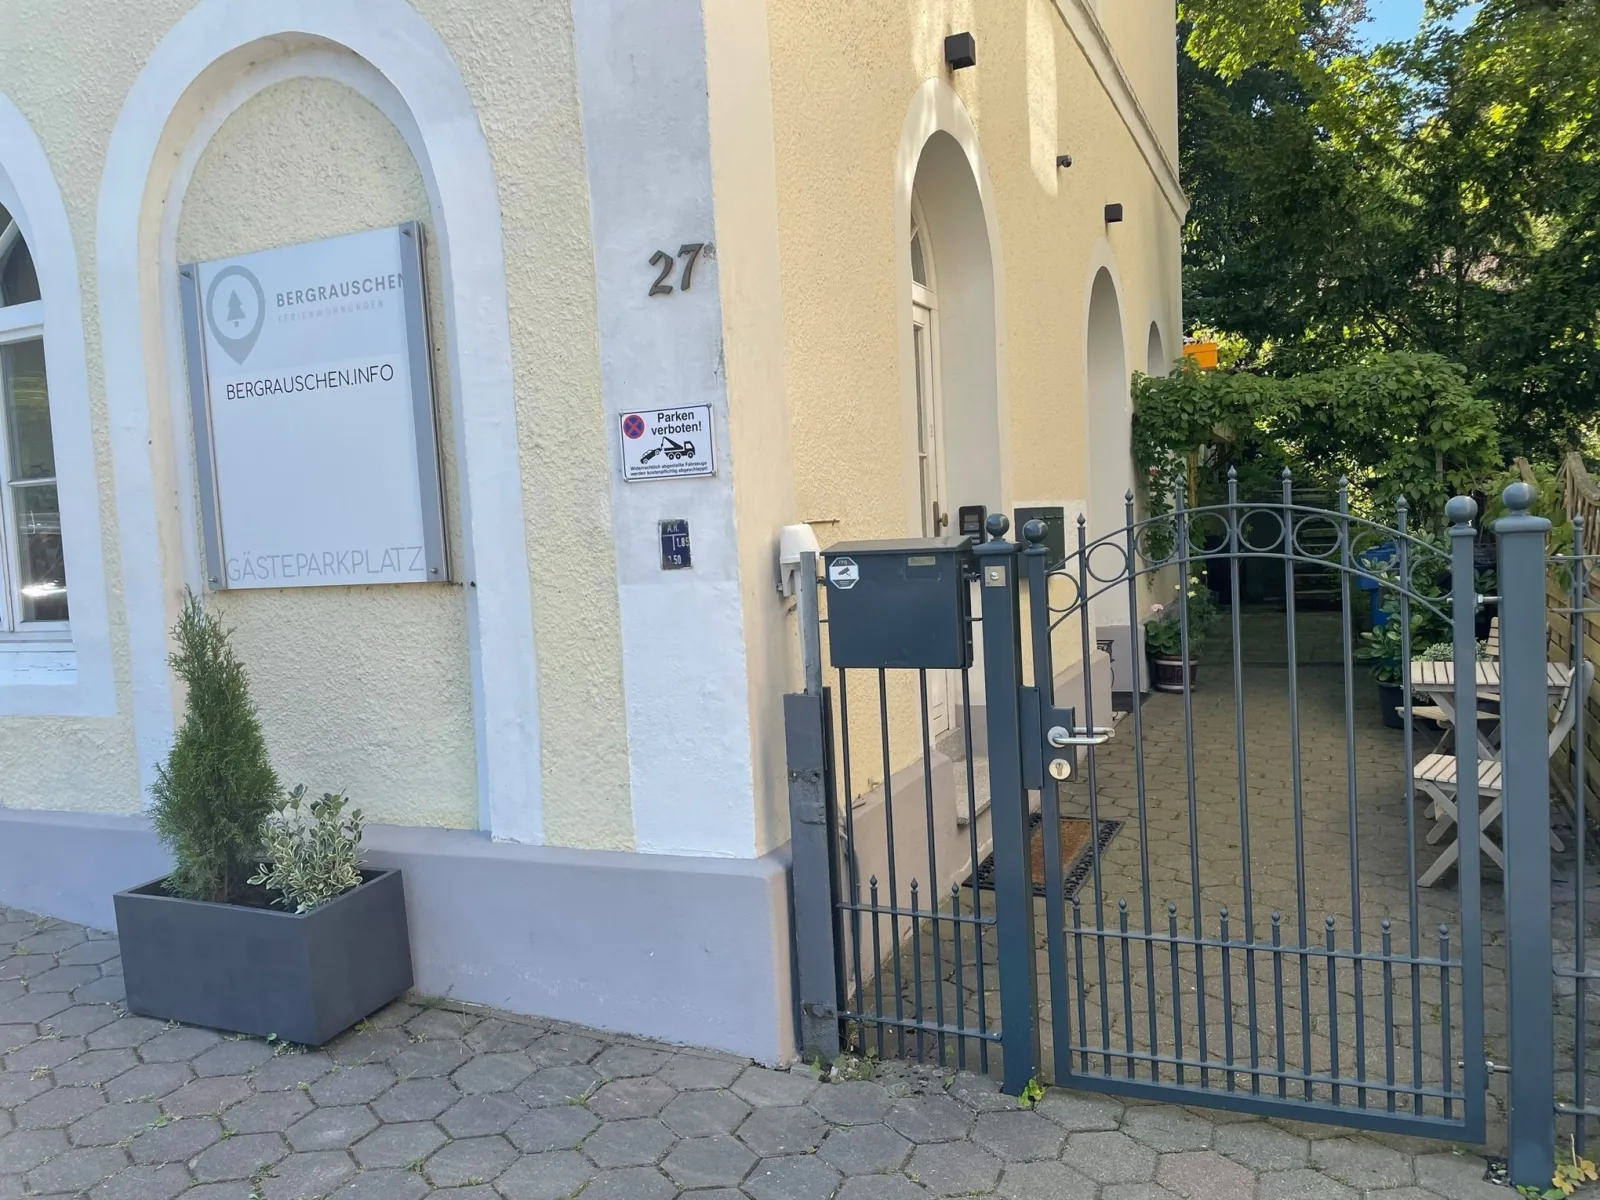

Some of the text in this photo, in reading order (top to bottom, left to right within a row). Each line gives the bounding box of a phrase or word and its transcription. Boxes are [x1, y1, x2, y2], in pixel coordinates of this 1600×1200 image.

[648, 243, 704, 296] 27
[277, 299, 384, 323] FERIENWOHNUNGEN
[226, 364, 394, 400] BERGRAUSCHEN.INFO
[651, 421, 702, 435] verboten!
[657, 411, 695, 423] Parken
[226, 546, 424, 581] GÄSTEPARKPLATZ
